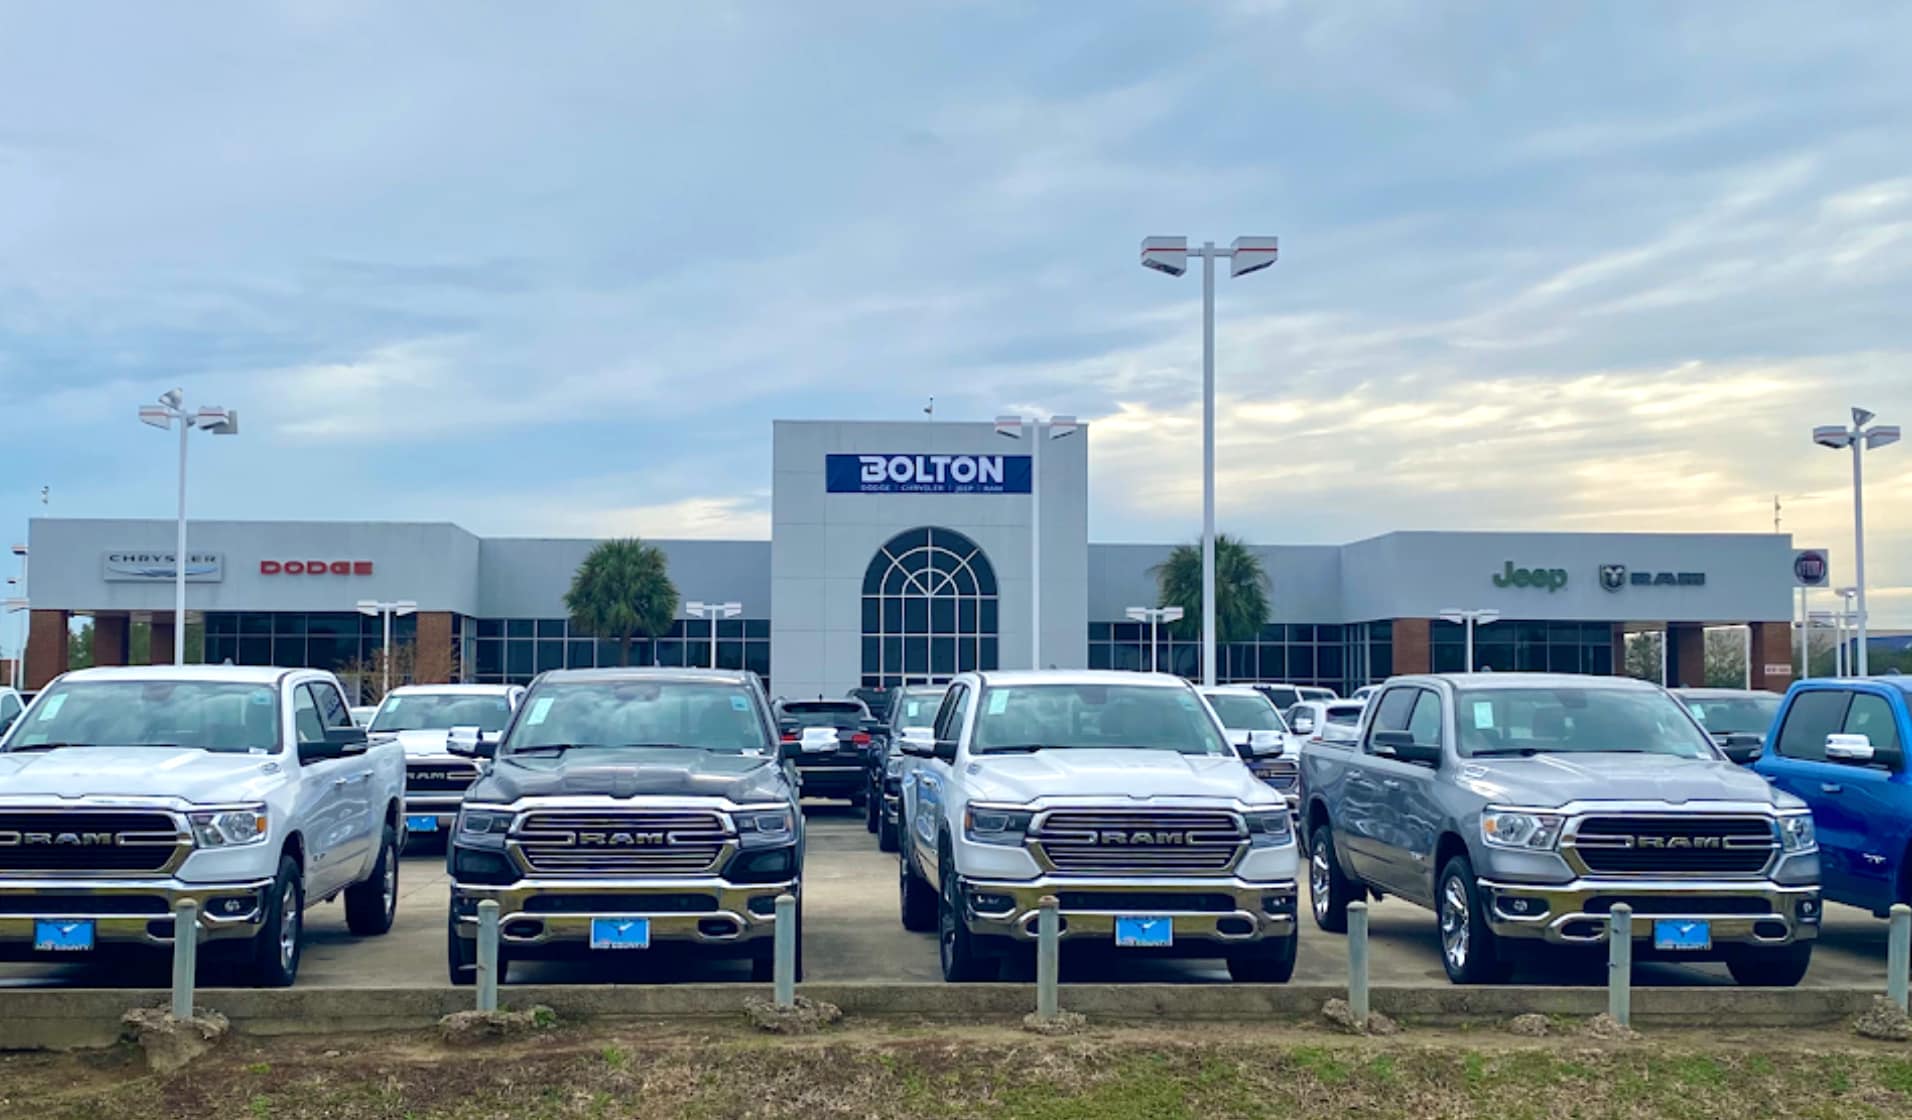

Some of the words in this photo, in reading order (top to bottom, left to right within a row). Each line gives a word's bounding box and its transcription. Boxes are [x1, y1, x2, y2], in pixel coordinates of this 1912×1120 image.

[859, 456, 1003, 483] BOLTON
[260, 560, 373, 576] DODGE
[1492, 561, 1568, 592] Jeep
[1630, 573, 1705, 586] RAM
[24, 832, 112, 845] RAM
[579, 832, 664, 845] RAM
[1100, 831, 1184, 845] RAM
[1638, 836, 1721, 849] RAM
